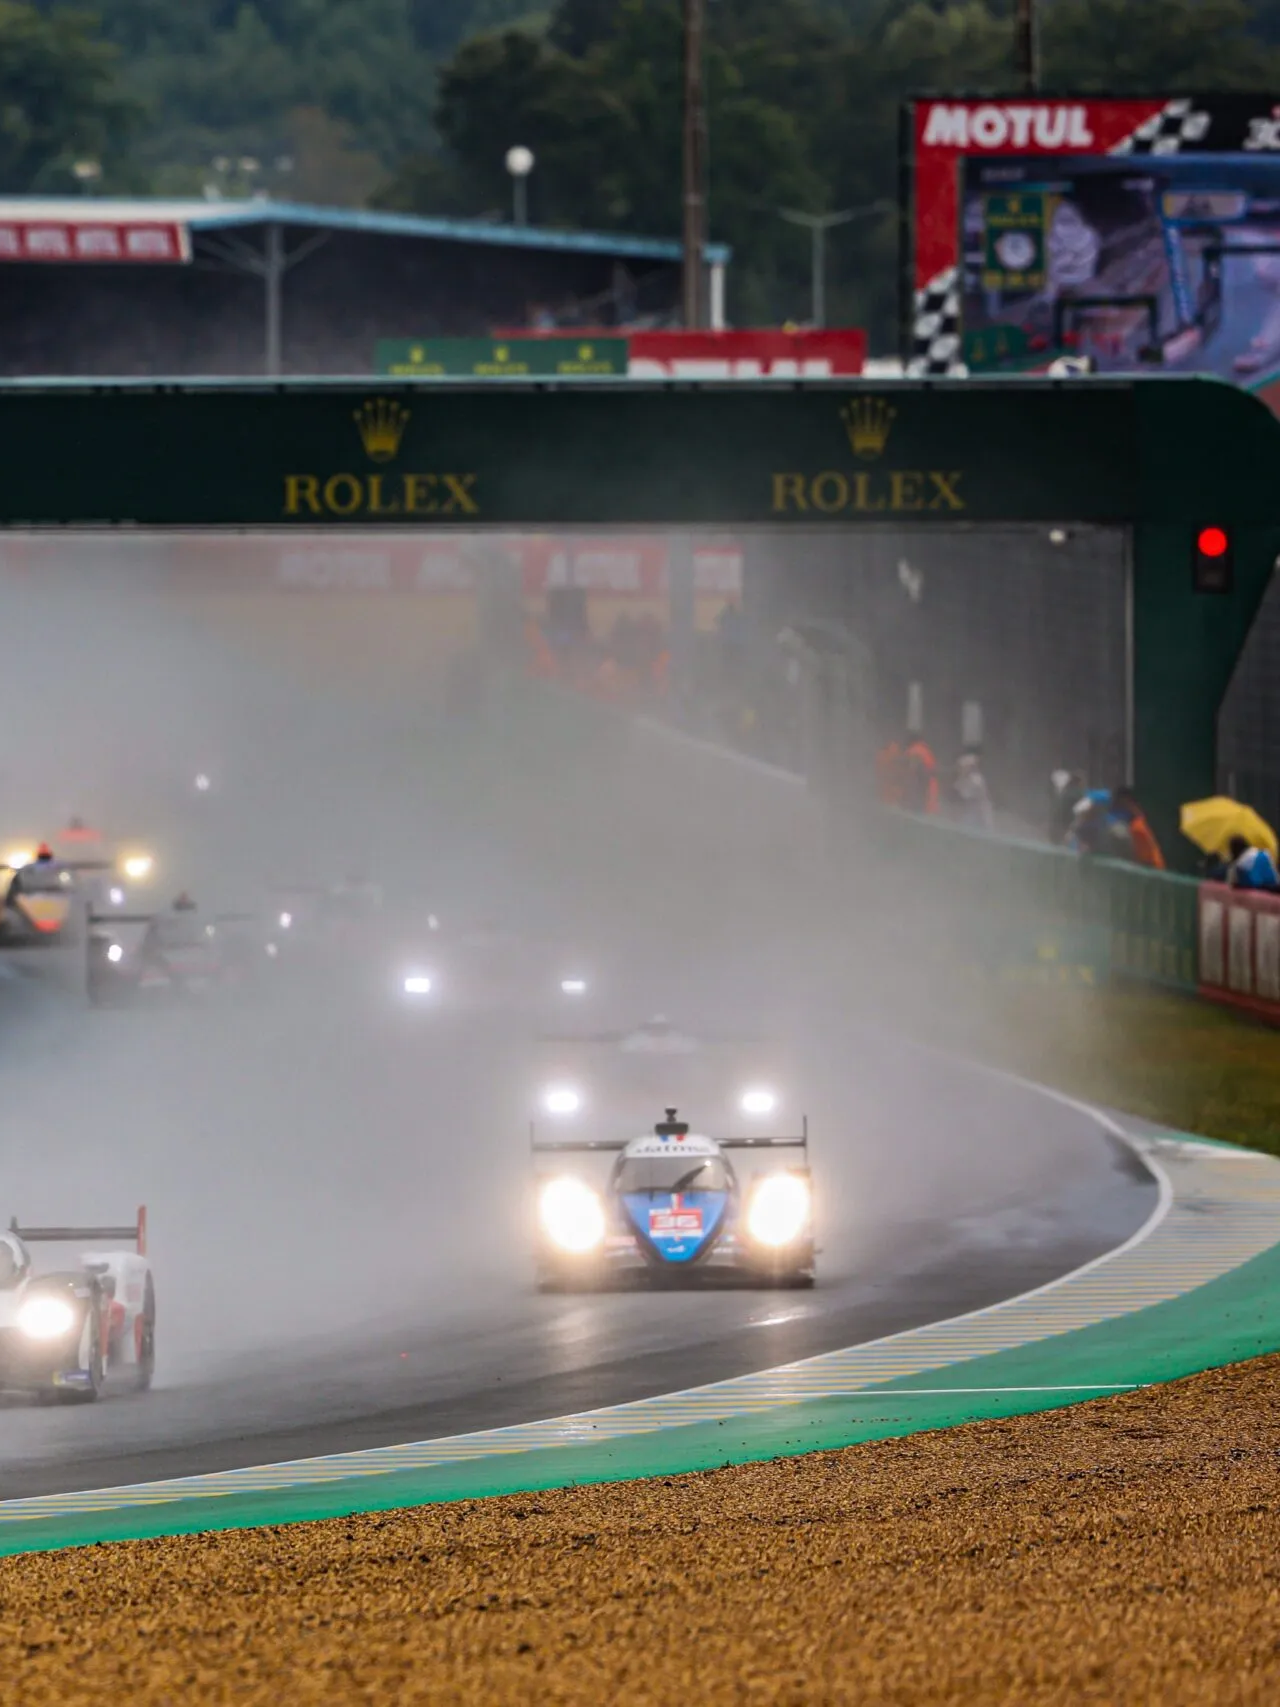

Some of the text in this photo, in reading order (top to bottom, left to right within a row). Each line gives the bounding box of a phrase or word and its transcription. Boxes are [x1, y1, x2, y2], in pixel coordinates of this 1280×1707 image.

[922, 104, 1094, 148] MOTUL
[285, 475, 478, 514] ROLEX
[773, 472, 965, 511] ROLEX
